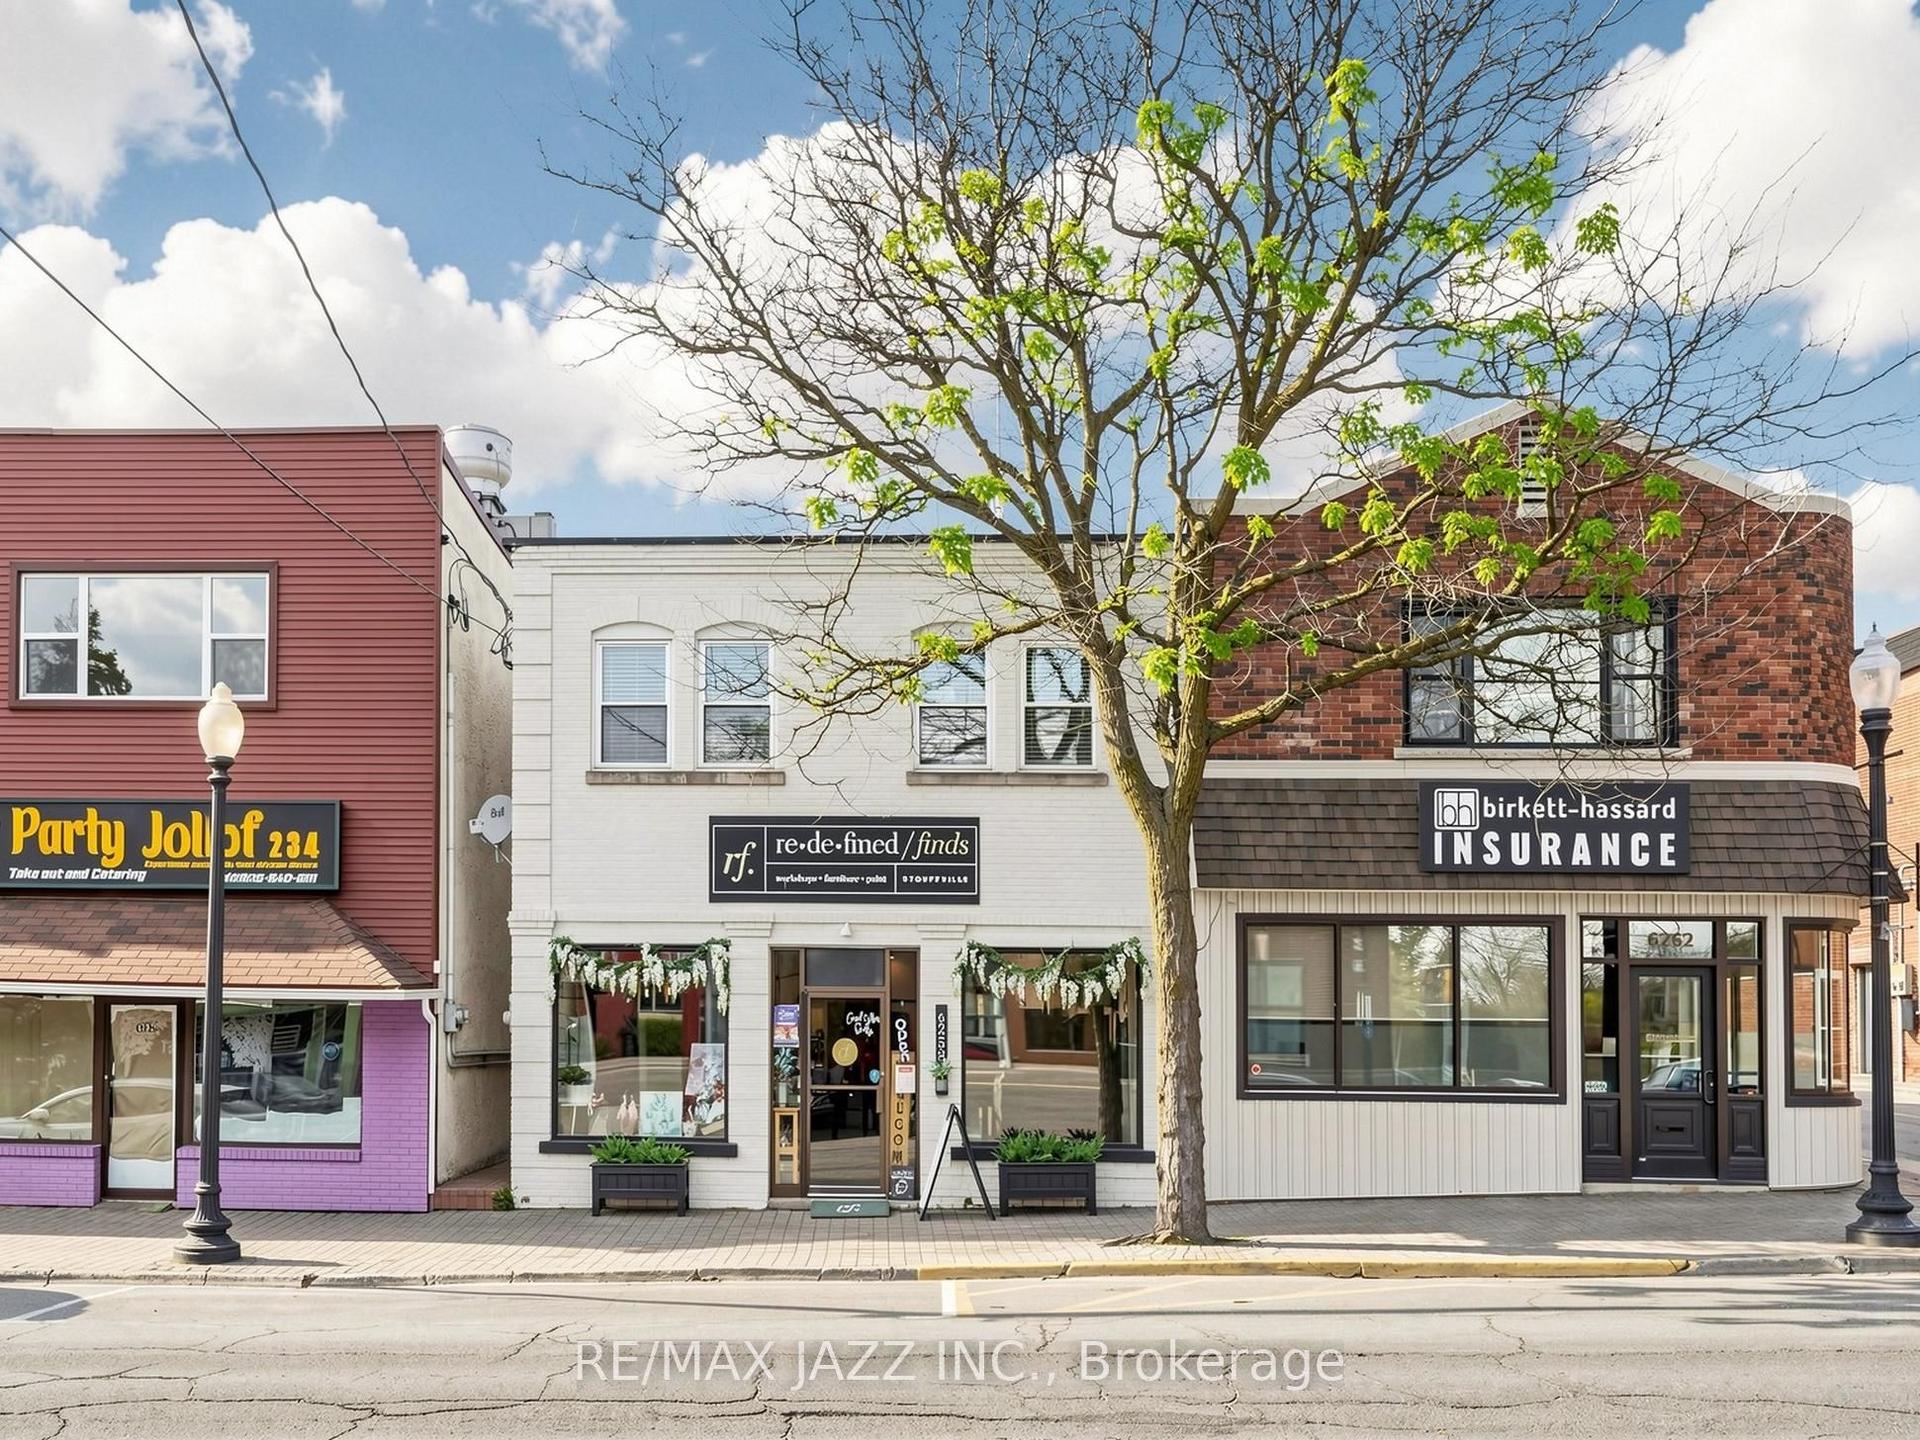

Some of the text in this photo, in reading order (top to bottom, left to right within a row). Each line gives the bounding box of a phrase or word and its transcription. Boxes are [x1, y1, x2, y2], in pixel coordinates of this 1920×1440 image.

[1483, 797, 1676, 819] birkett-hassard
[11, 806, 125, 868] Party
[269, 831, 320, 858] 234
[1433, 831, 1677, 867] INSURANCE
[64, 868, 90, 880] and
